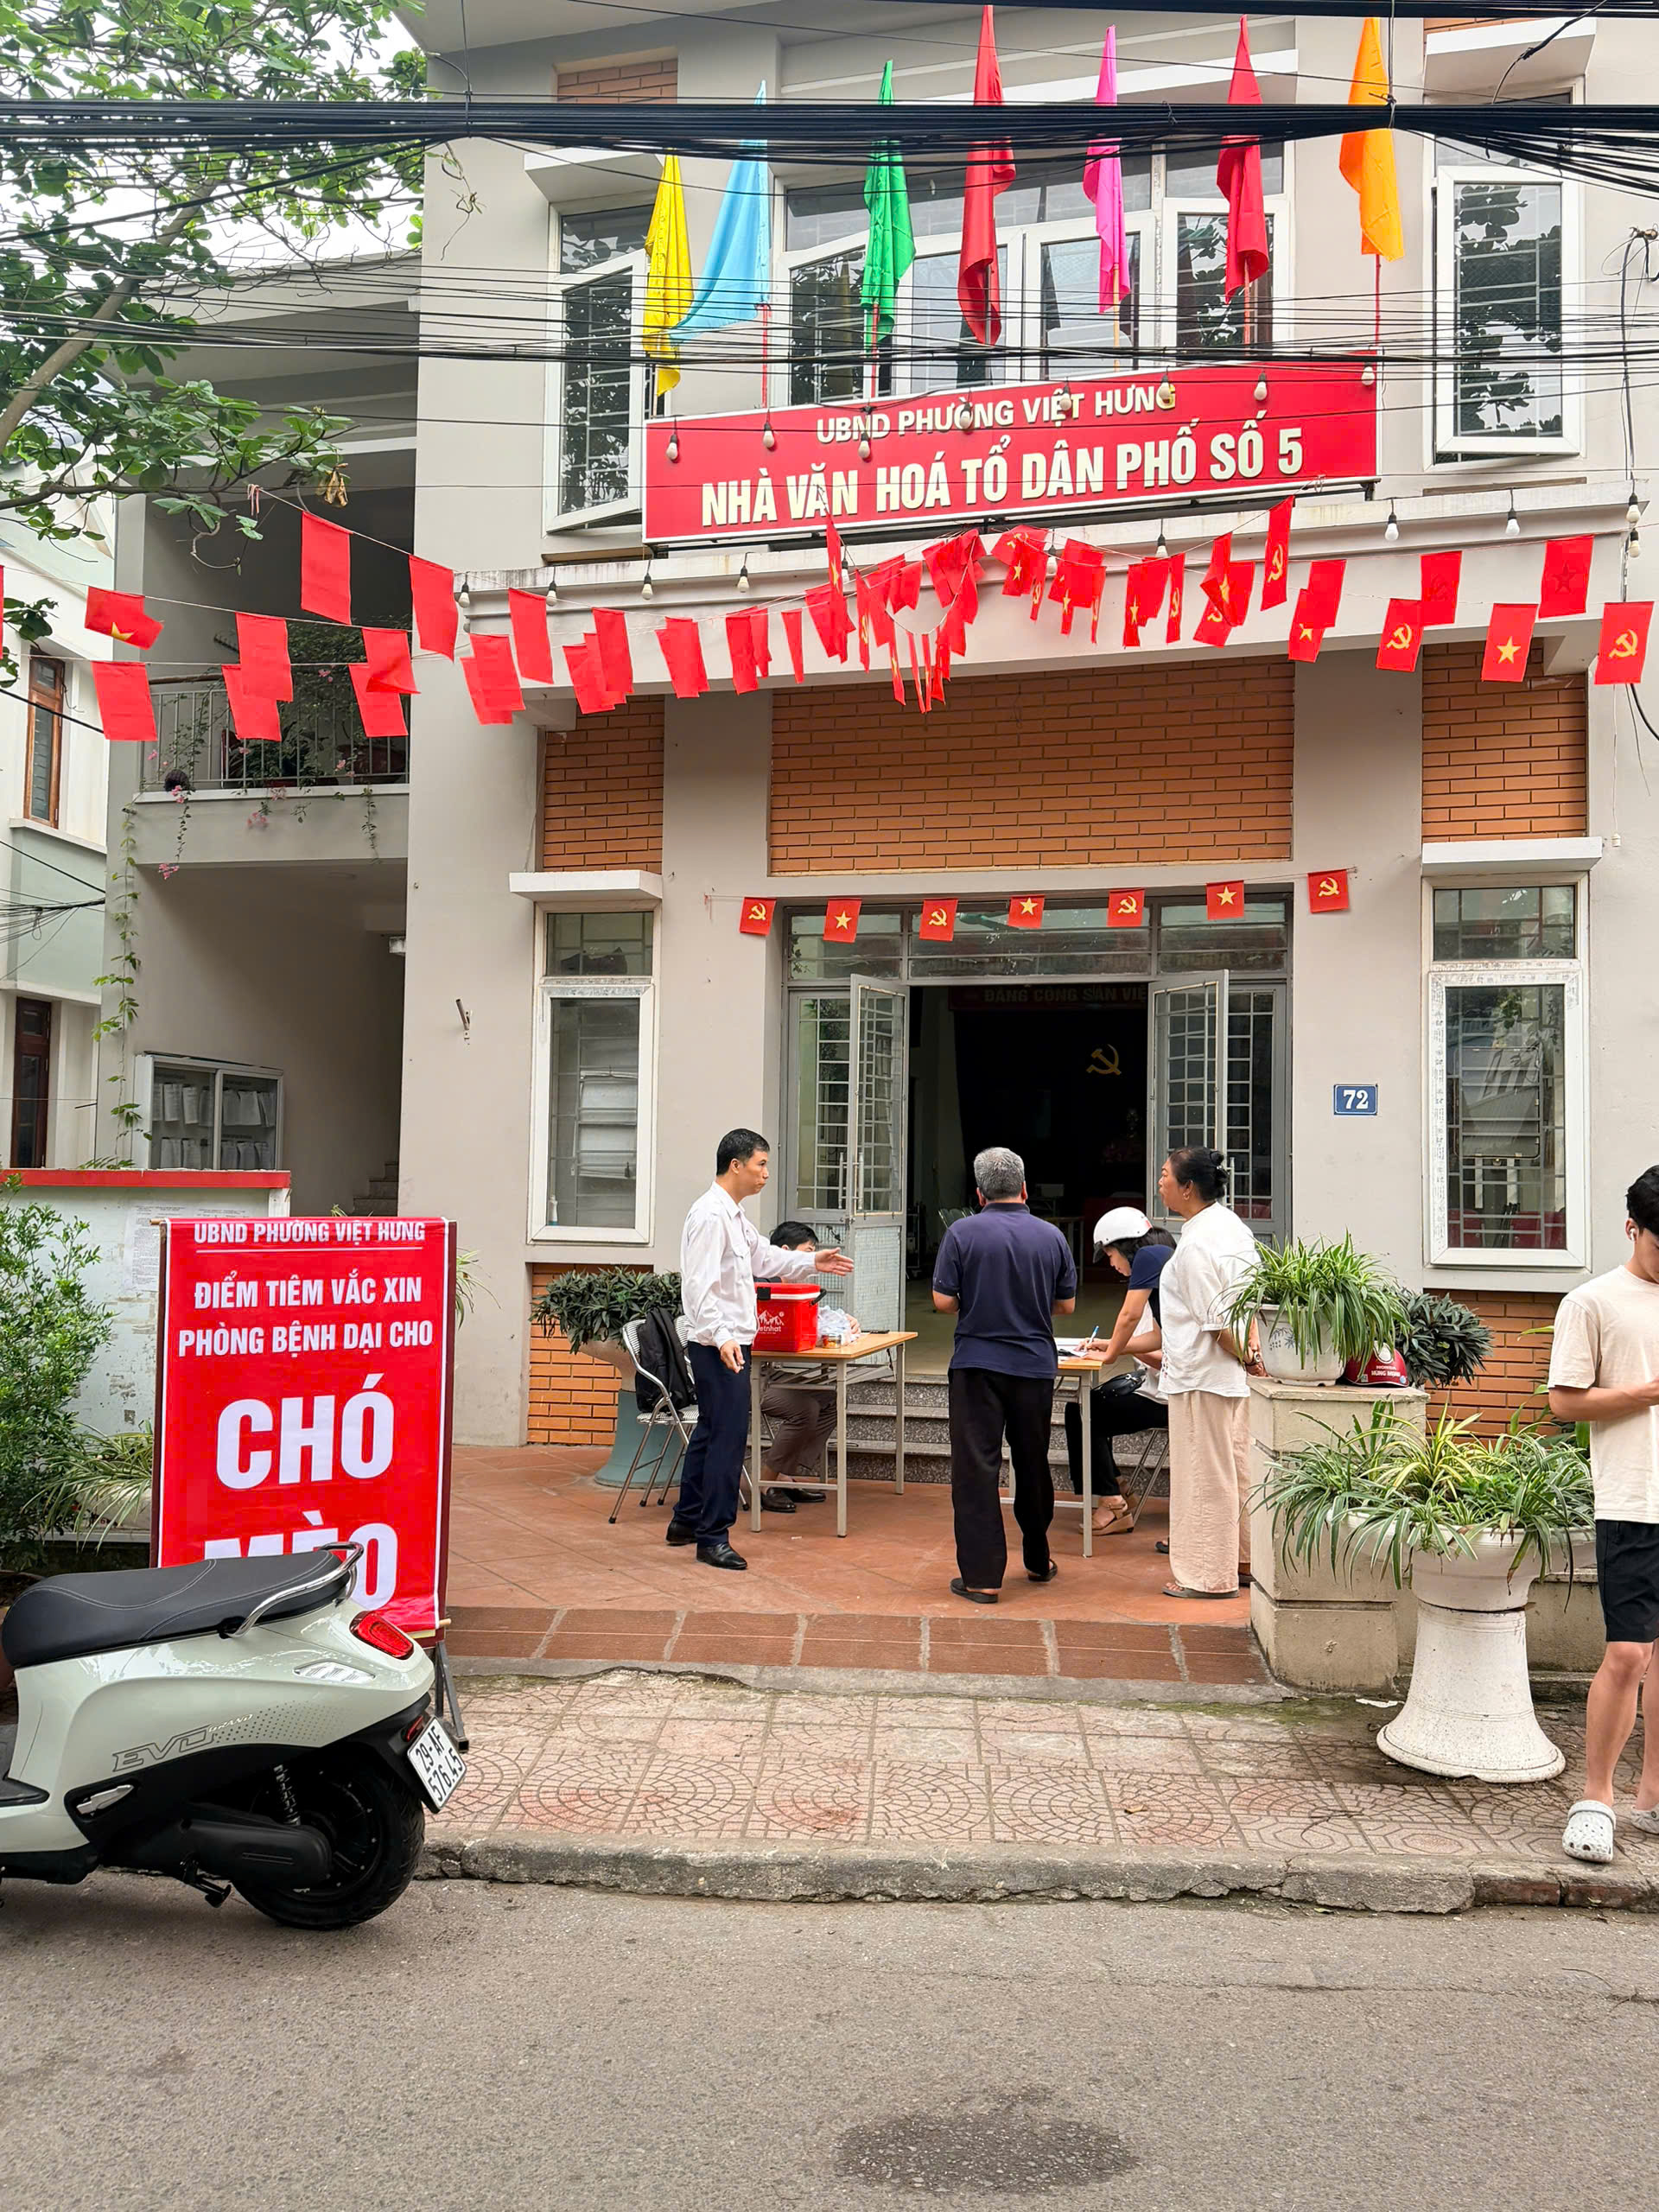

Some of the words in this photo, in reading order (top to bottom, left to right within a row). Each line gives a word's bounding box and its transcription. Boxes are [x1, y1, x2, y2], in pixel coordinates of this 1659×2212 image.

[817, 414, 890, 442] UBND
[702, 467, 778, 526] NHÀ
[786, 462, 858, 519] VĂN
[876, 451, 951, 512] HOÁ
[961, 433, 1010, 504] TỔ
[1021, 440, 1103, 499] DÂN
[1116, 418, 1199, 491] PHỐ
[1210, 410, 1268, 480] SỐ
[1278, 429, 1302, 474] 5
[1344, 1090, 1369, 1109] 72
[194, 1223, 247, 1243] UBND
[253, 1219, 329, 1243] PHƯỜNG
[335, 1220, 372, 1246] VIỆT
[194, 1270, 257, 1309] ĐIỂM
[266, 1274, 323, 1307] TIÊM
[331, 1268, 376, 1305] VẮC
[383, 1276, 422, 1304] XIN
[178, 1322, 264, 1357] PHÒNG
[272, 1320, 336, 1357] BỆNH
[343, 1322, 382, 1354] DẠI
[389, 1320, 433, 1348] CHO
[216, 1372, 395, 1491] CHÓ
[112, 1724, 214, 1772] EVO
[428, 1747, 463, 1802] 576.45
